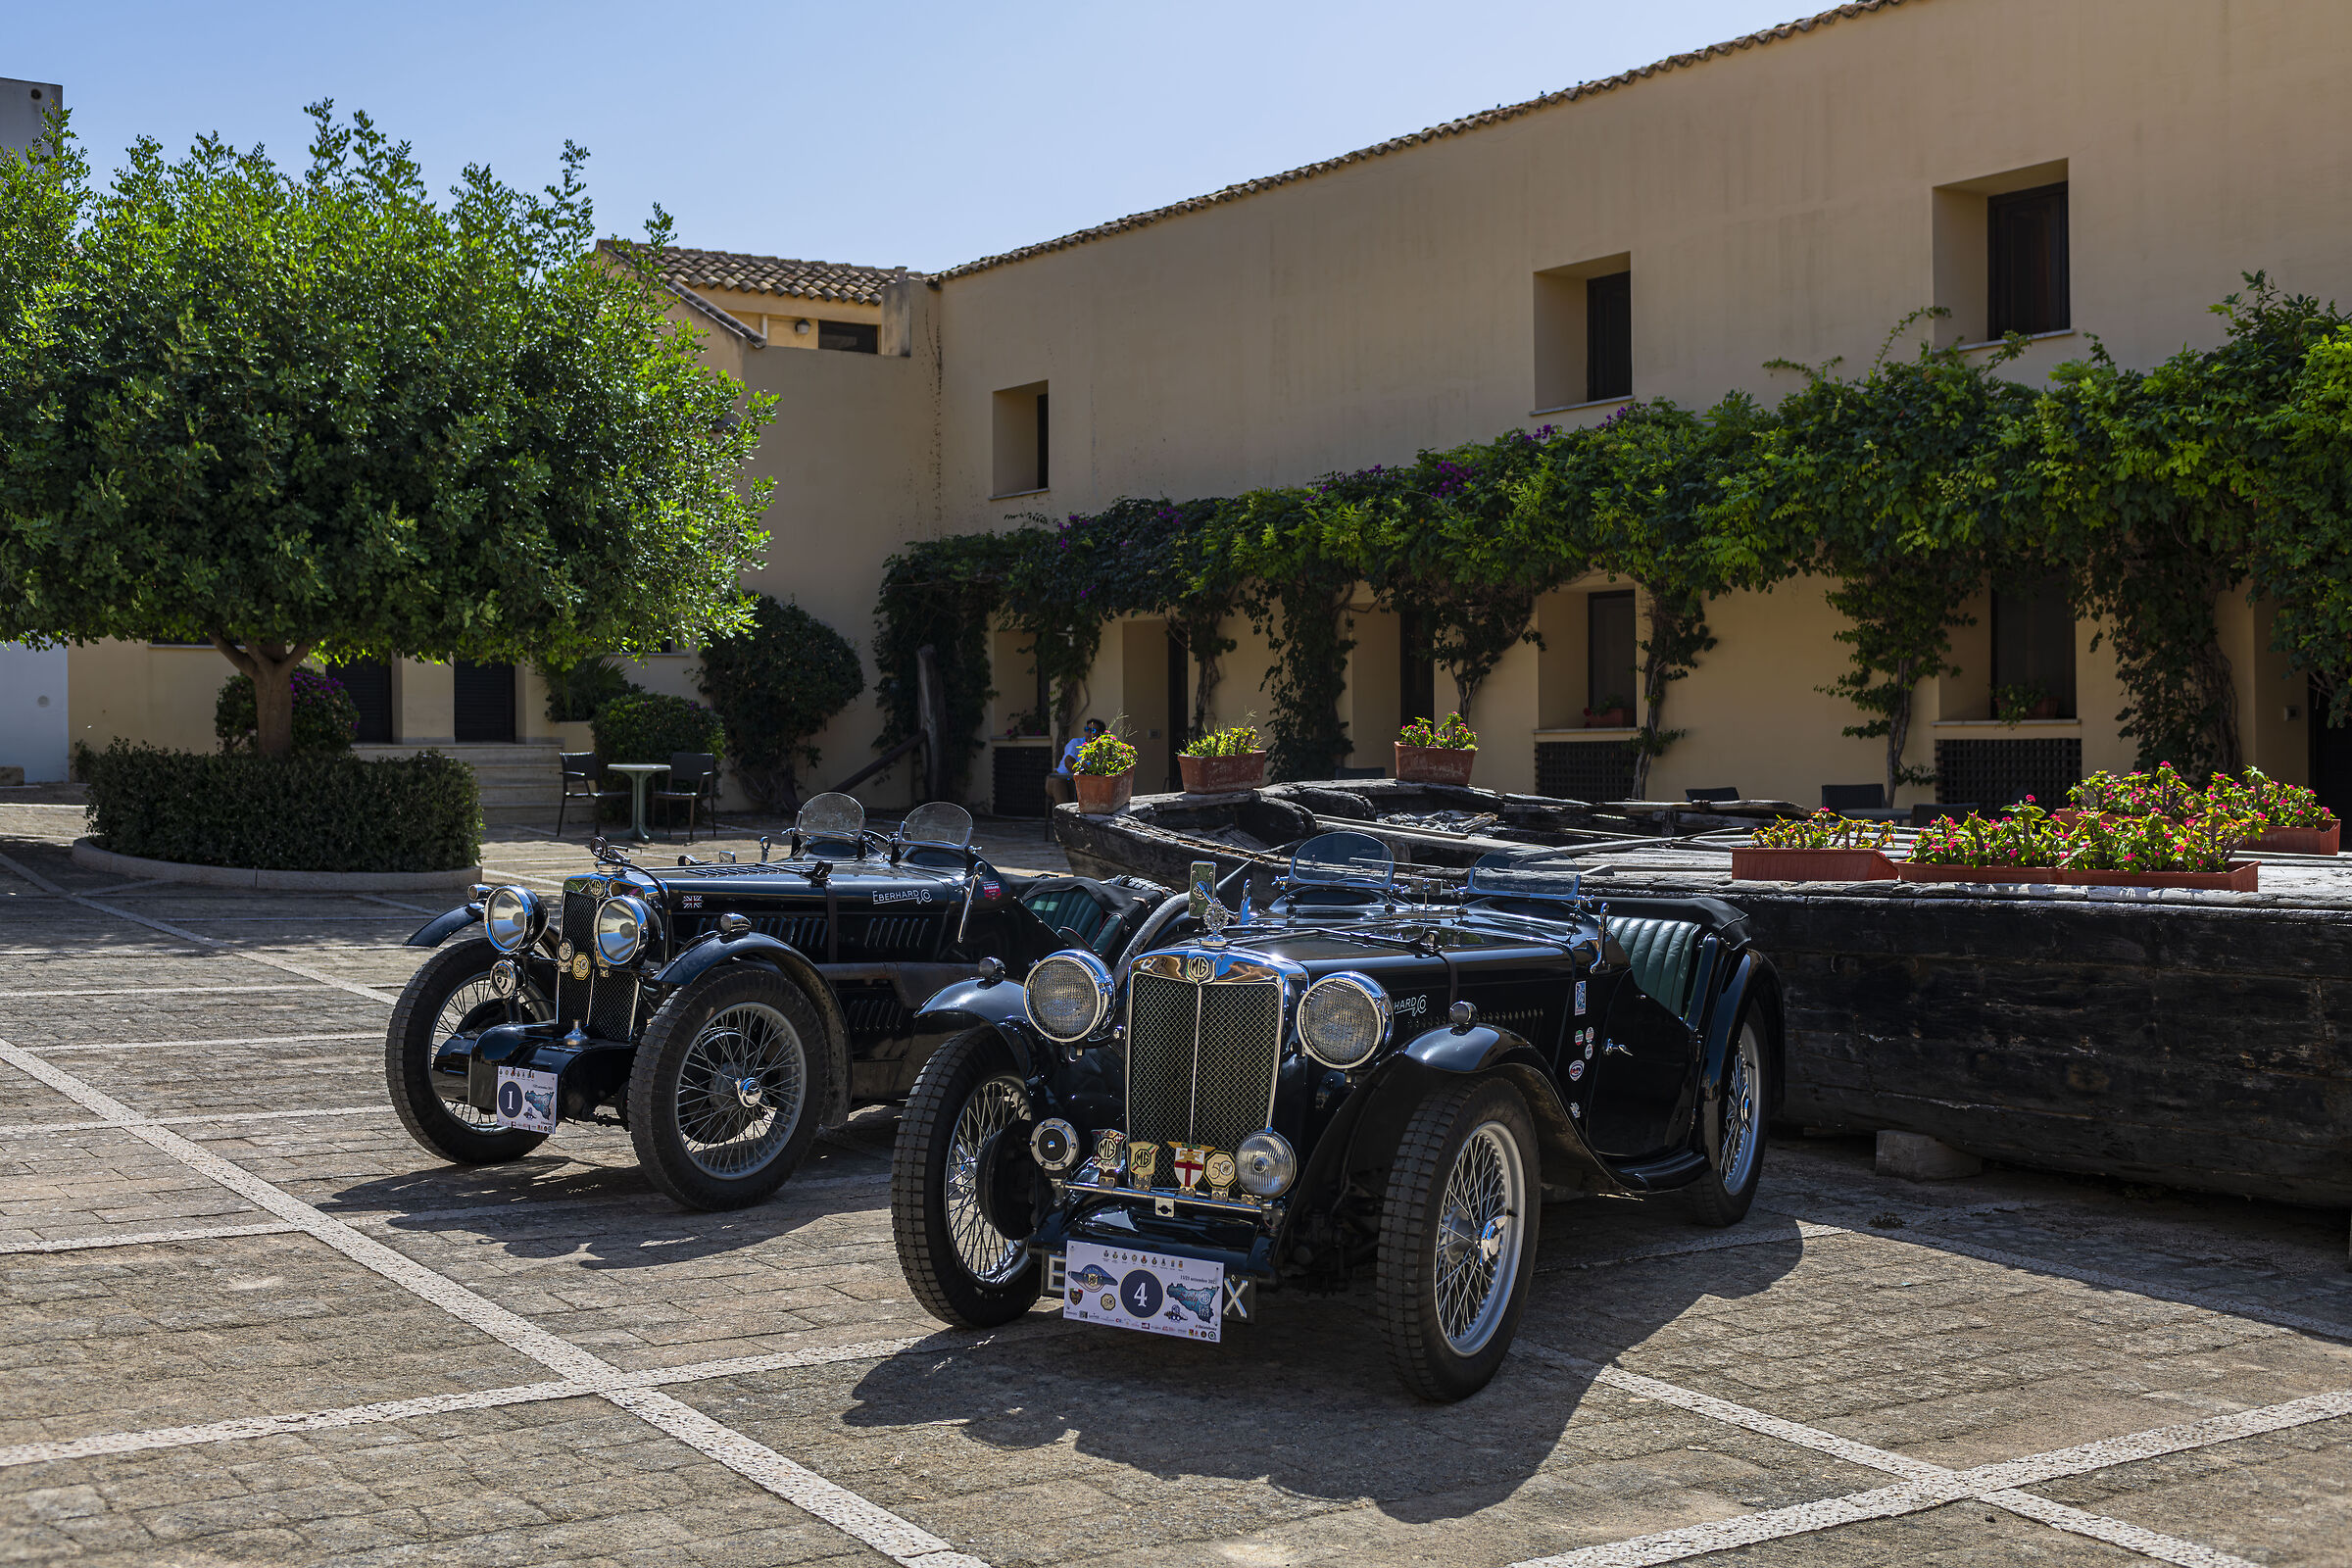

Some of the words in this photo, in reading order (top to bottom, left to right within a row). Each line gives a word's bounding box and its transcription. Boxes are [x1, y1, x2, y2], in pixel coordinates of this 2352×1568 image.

[872, 890, 919, 903] EBERHARD
[1191, 957, 1208, 976] MG
[1394, 997, 1417, 1011] HARD
[508, 1090, 514, 1110] 1
[1099, 1139, 1116, 1158] MG
[1136, 1151, 1151, 1166] MG
[1133, 1282, 1149, 1307] 4
[1223, 1277, 1249, 1319] X
